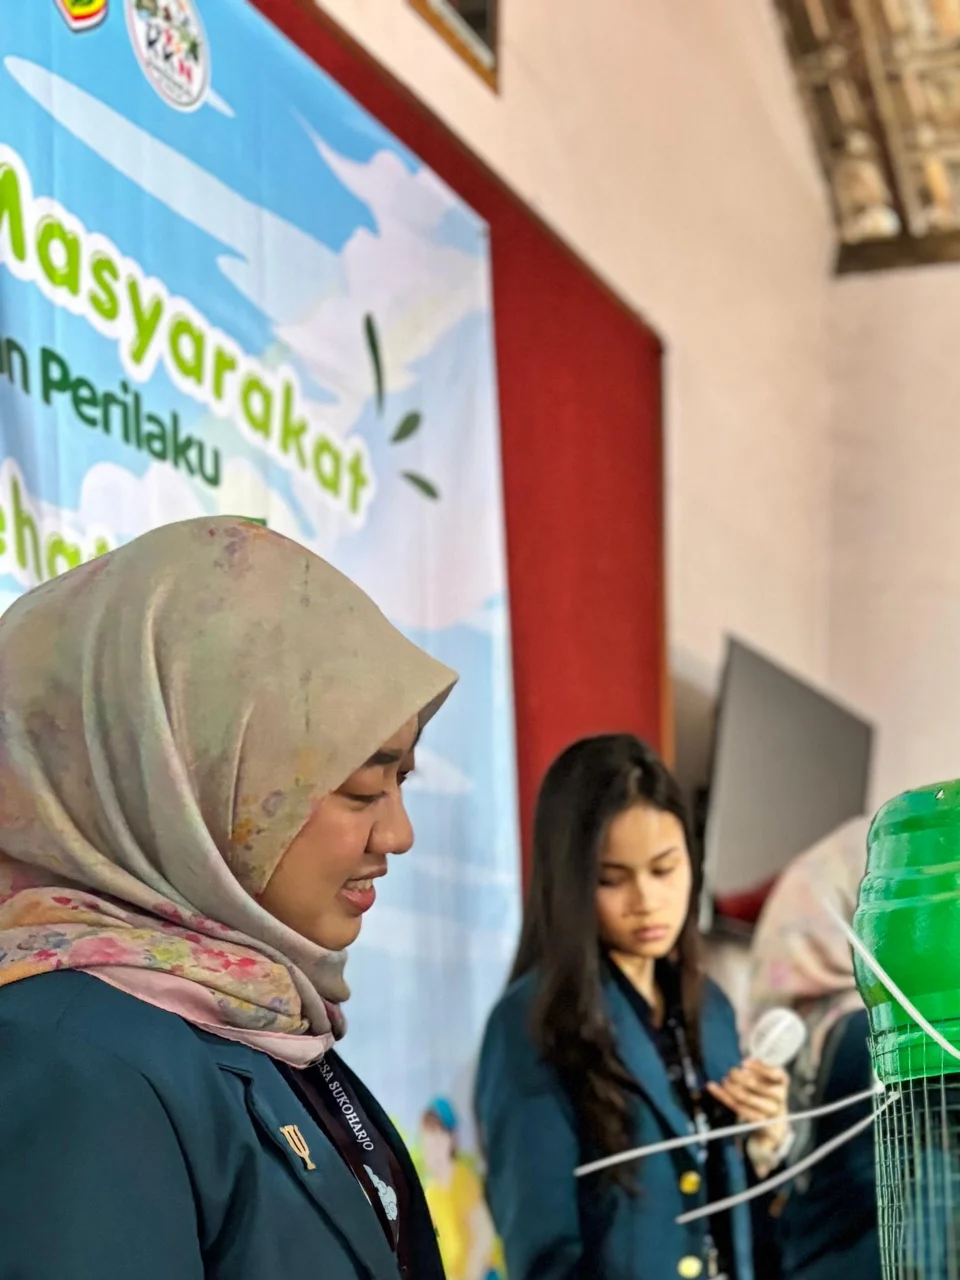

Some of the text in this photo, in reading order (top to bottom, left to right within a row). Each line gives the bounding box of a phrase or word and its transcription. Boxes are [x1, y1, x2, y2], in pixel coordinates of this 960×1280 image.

[0, 336, 220, 487] n Perilaku
[316, 1056, 374, 1151] ESA SUKOHARJO
